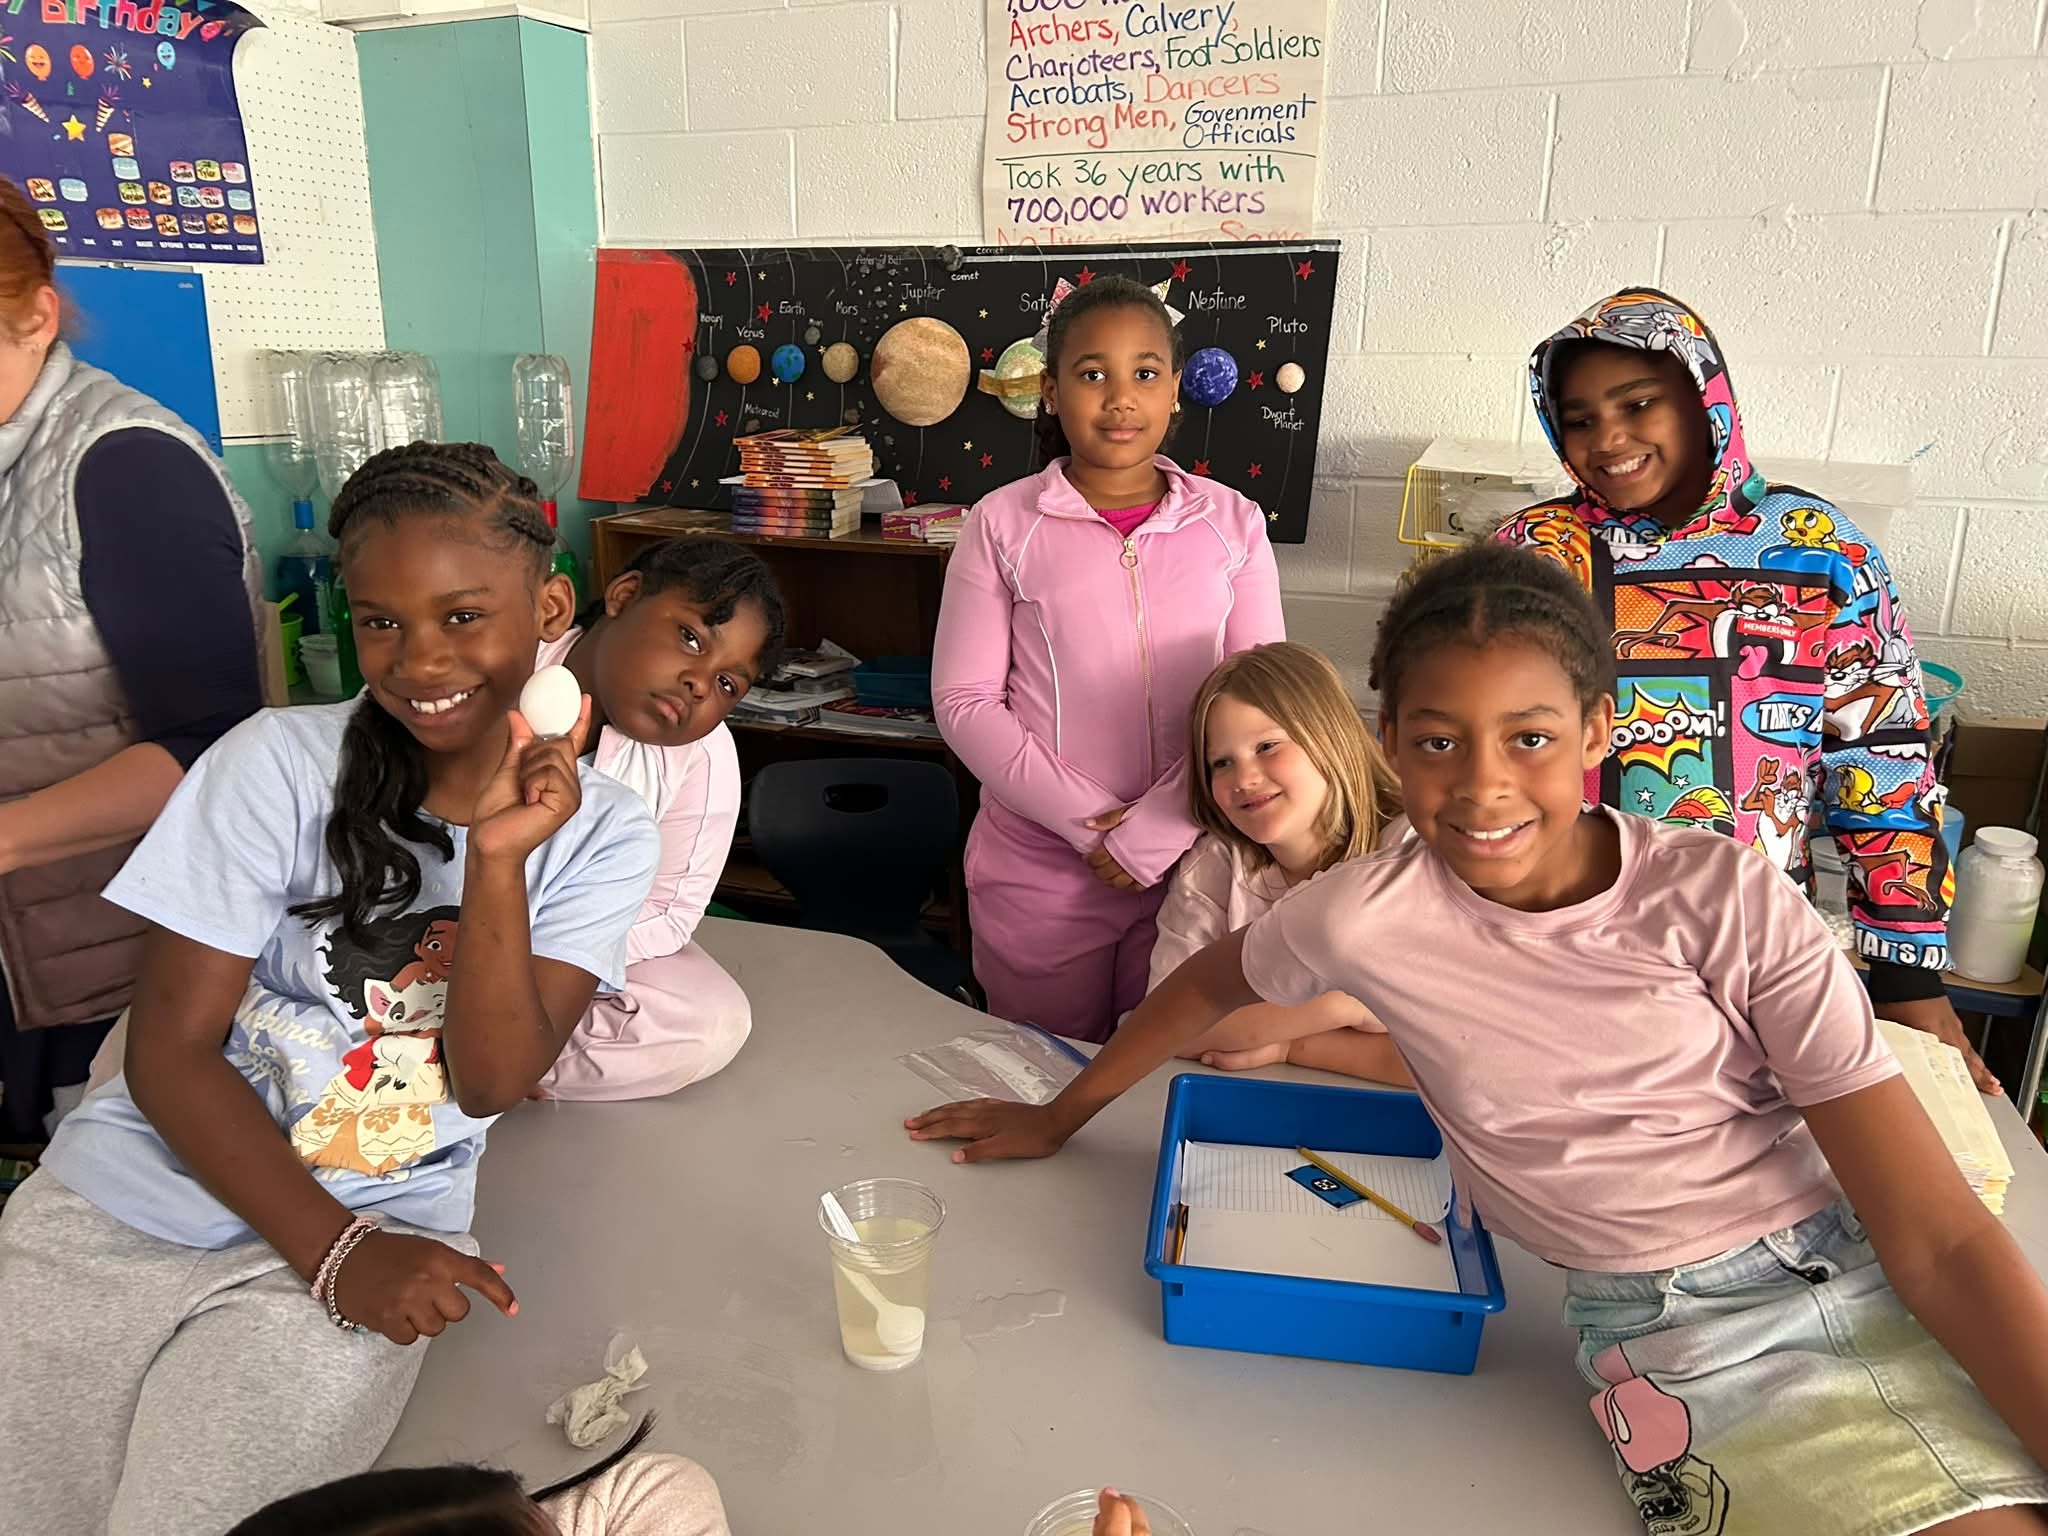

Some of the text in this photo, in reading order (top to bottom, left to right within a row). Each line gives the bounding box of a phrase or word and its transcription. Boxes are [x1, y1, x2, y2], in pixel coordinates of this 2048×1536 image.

[1009, 13, 1120, 50] Archers,
[1164, 36, 1217, 69] Foot
[1221, 25, 1321, 64] Soldiers
[1010, 72, 1280, 111] Acrobats, Dancers
[1007, 113, 1108, 148] Strong
[1114, 104, 1176, 131] Men,
[1183, 122, 1296, 148] Officials
[1002, 154, 1285, 196] Took 36 years with
[1008, 187, 1266, 226] 700,000 workers
[901, 283, 945, 304] Jupiter
[1188, 287, 1247, 313] Neptune
[779, 301, 806, 315] Earth
[835, 301, 858, 316] Mars
[736, 326, 765, 339] Venus
[1266, 316, 1308, 334] Pluto
[1261, 406, 1296, 421] Dwarf
[1273, 418, 1304, 431] Planet
[1605, 701, 1726, 757] OOOOM!
